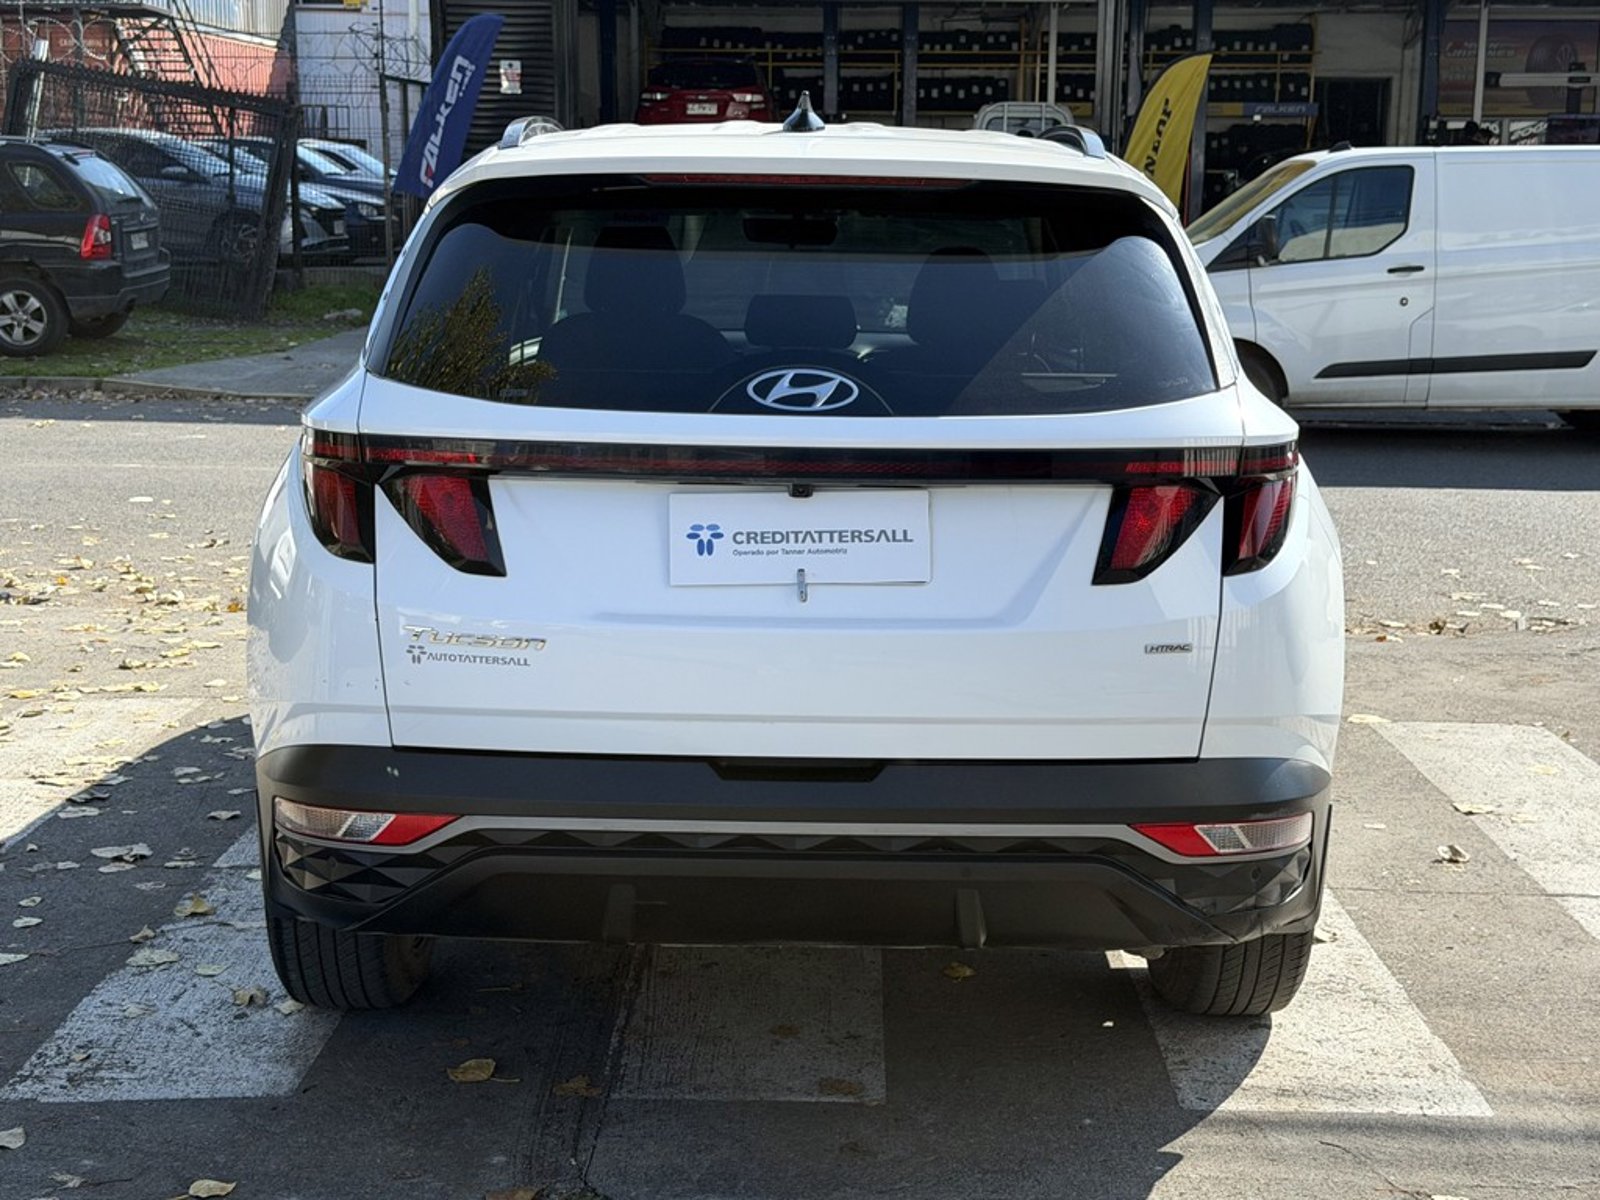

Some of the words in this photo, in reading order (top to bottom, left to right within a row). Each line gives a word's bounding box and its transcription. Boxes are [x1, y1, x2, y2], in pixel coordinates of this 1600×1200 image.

[420, 55, 470, 188] FALKEN
[732, 529, 914, 545] CREDITATTERSALL
[732, 548, 764, 557] Operado
[766, 549, 779, 557] por
[781, 547, 805, 556] Tanner
[1148, 643, 1191, 654] HTRAC
[427, 652, 531, 667] AUTOTATTERSALL
